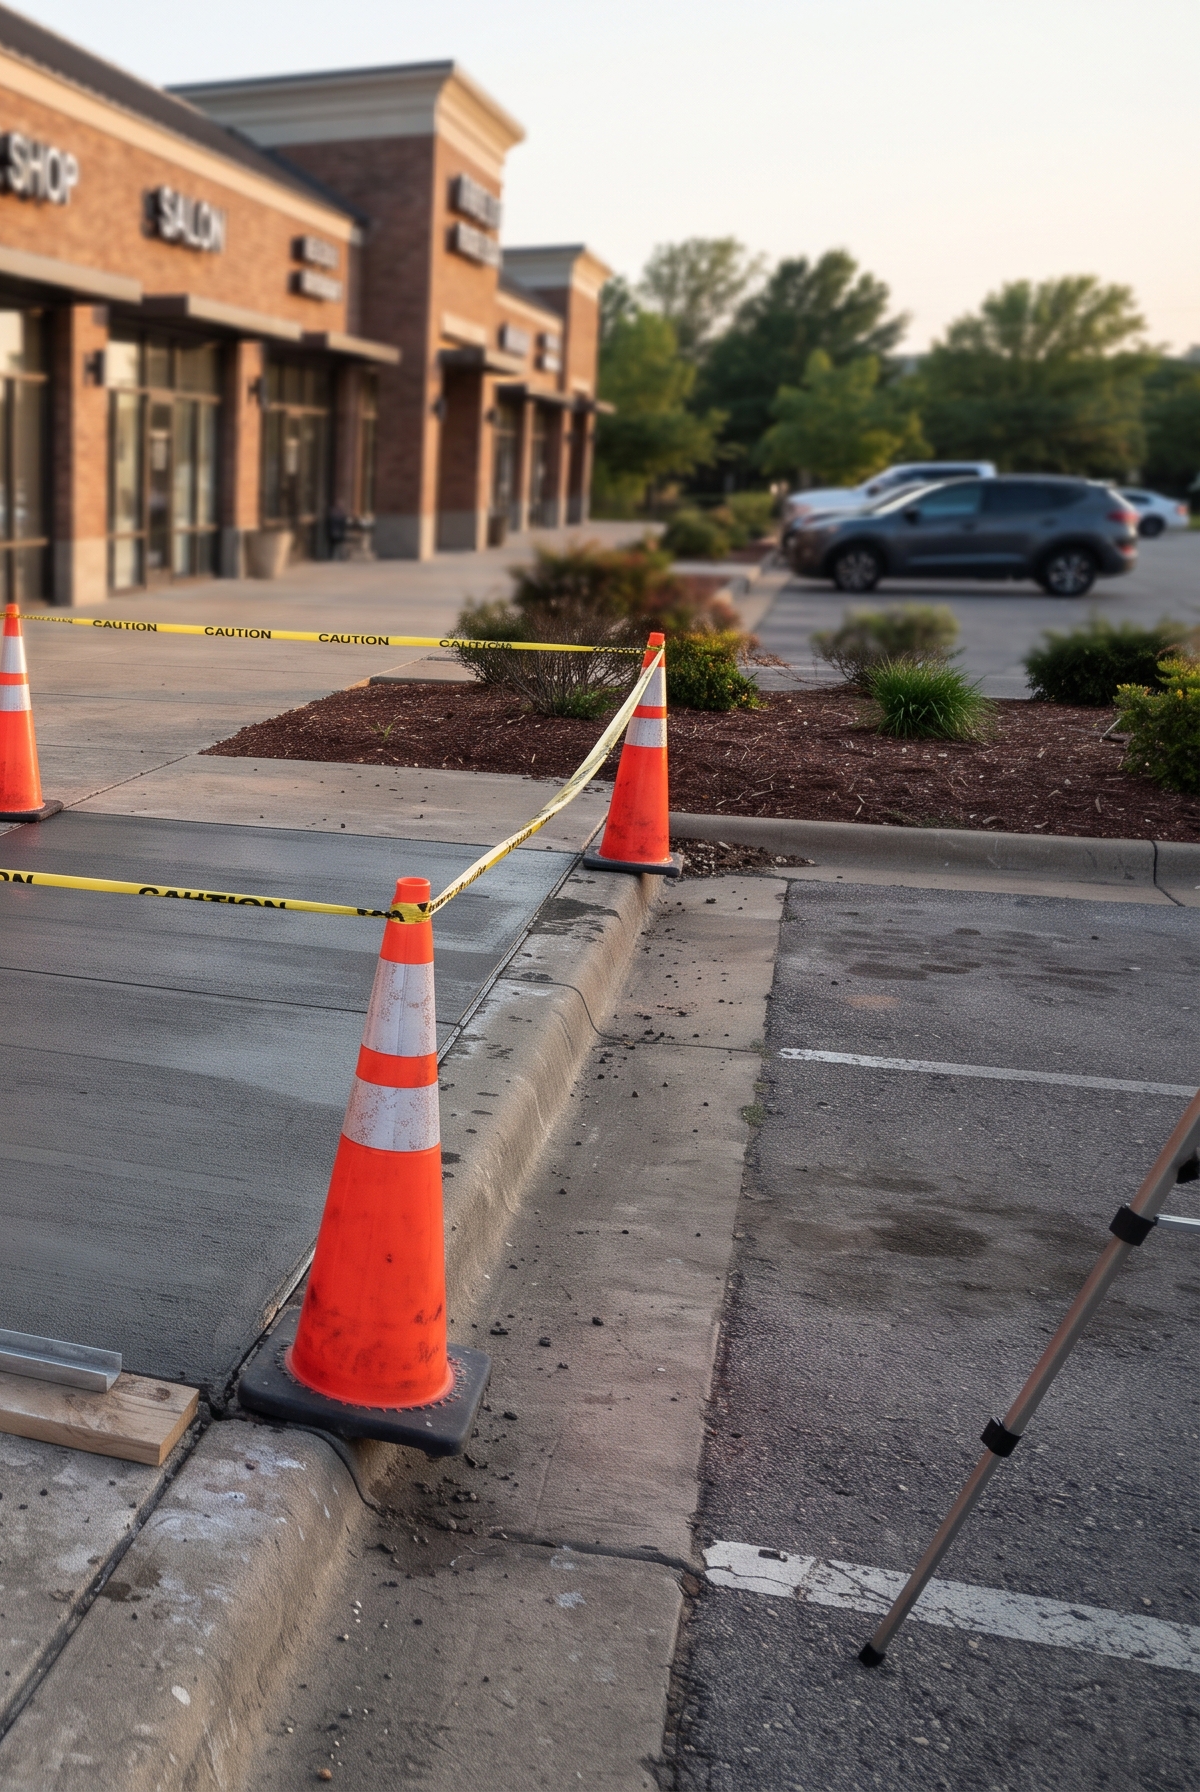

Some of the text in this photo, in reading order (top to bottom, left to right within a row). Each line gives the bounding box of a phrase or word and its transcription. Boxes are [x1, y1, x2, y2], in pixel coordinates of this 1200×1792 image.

[6, 132, 80, 205] SHOP
[158, 184, 228, 253] SALON
[93, 619, 158, 632] CAUTION
[204, 626, 272, 640] CAUTION
[318, 633, 390, 646] CAUTION
